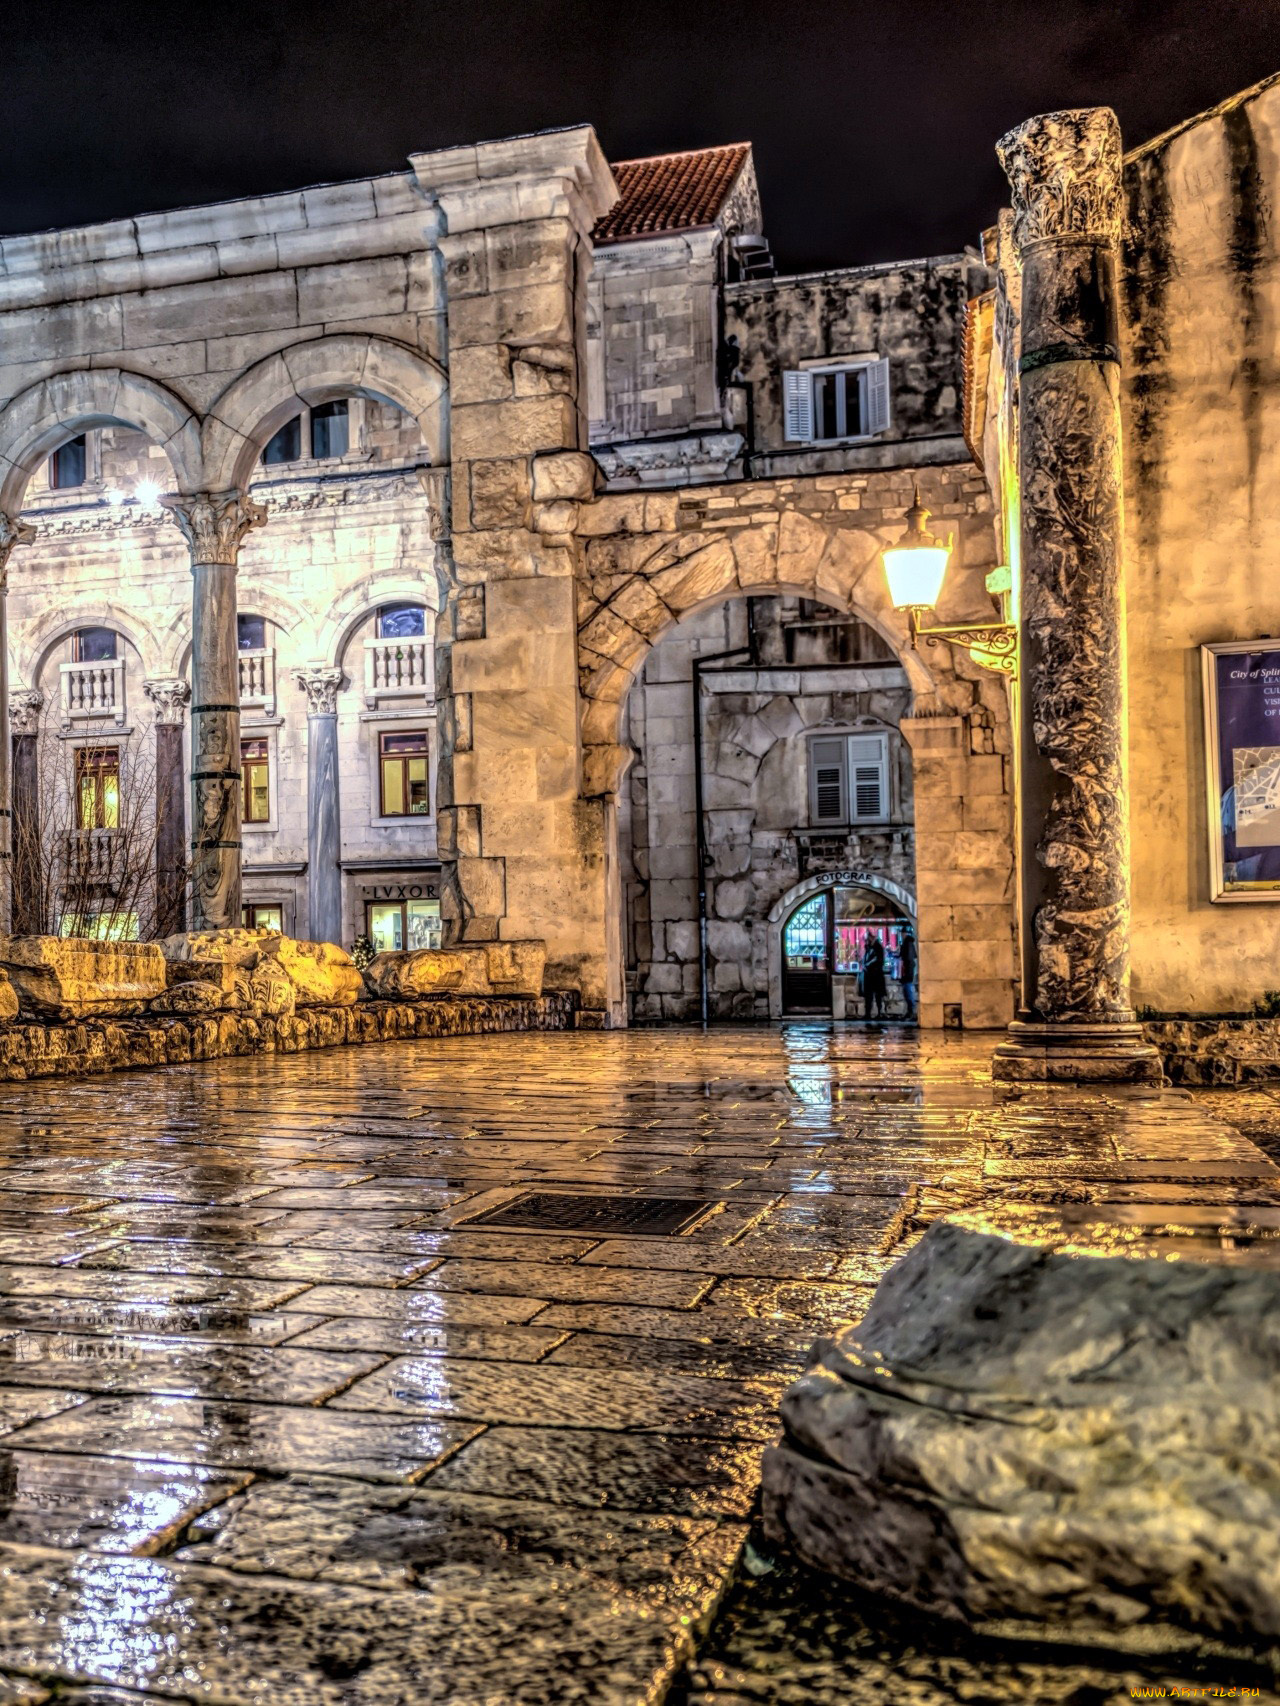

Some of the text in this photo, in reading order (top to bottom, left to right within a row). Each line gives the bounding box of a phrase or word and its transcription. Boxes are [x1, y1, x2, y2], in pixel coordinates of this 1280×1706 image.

[1230, 670, 1248, 680] City
[1249, 669, 1260, 679] of
[816, 872, 872, 883] FOTOGRAF
